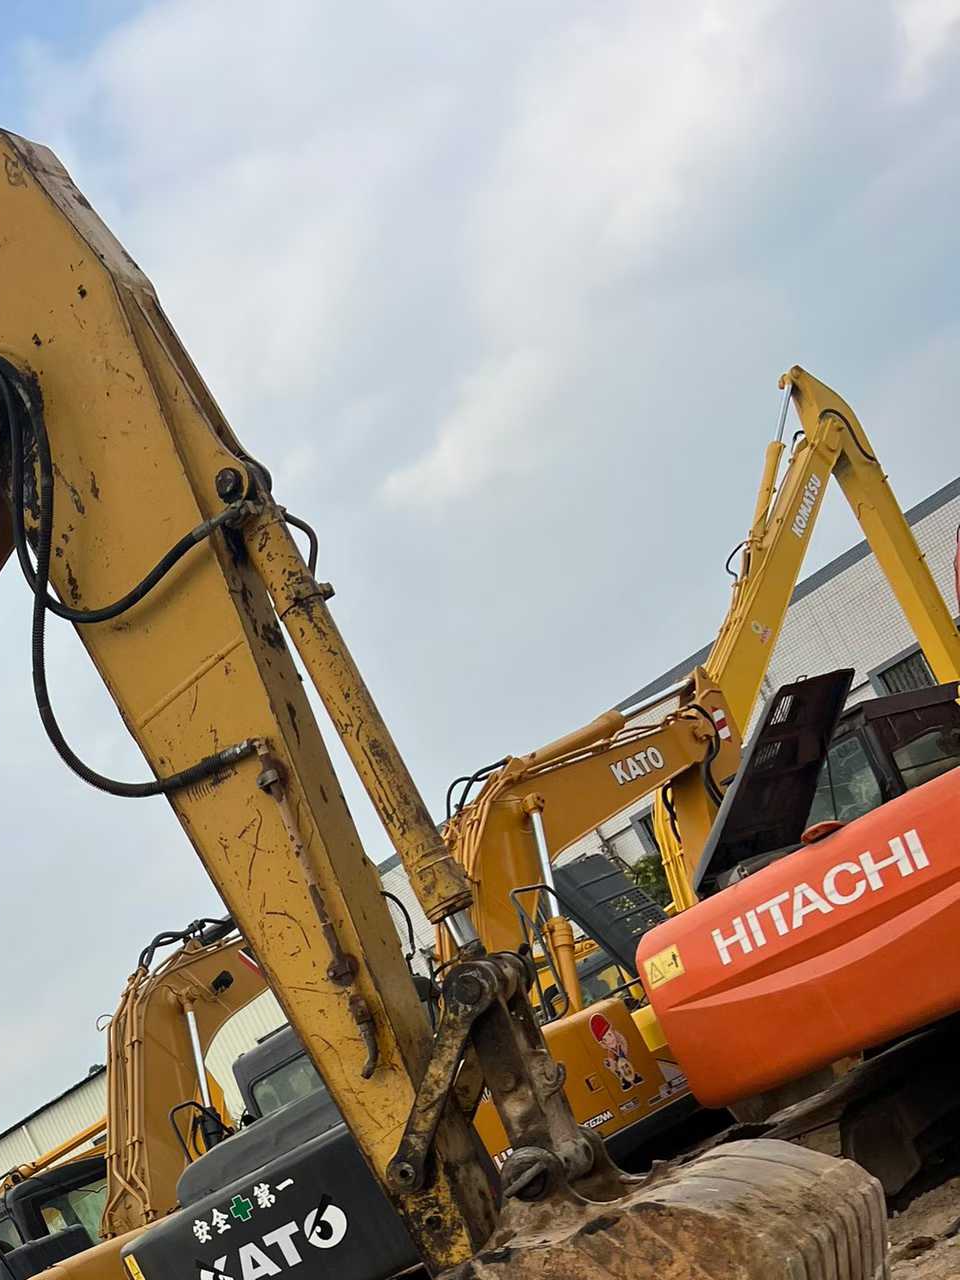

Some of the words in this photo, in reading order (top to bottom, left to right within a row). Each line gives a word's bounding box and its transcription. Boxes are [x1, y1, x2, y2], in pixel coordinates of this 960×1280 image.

[792, 474, 821, 538] KOMATSU
[610, 747, 664, 785] KATO
[711, 829, 930, 965] HITACHI
